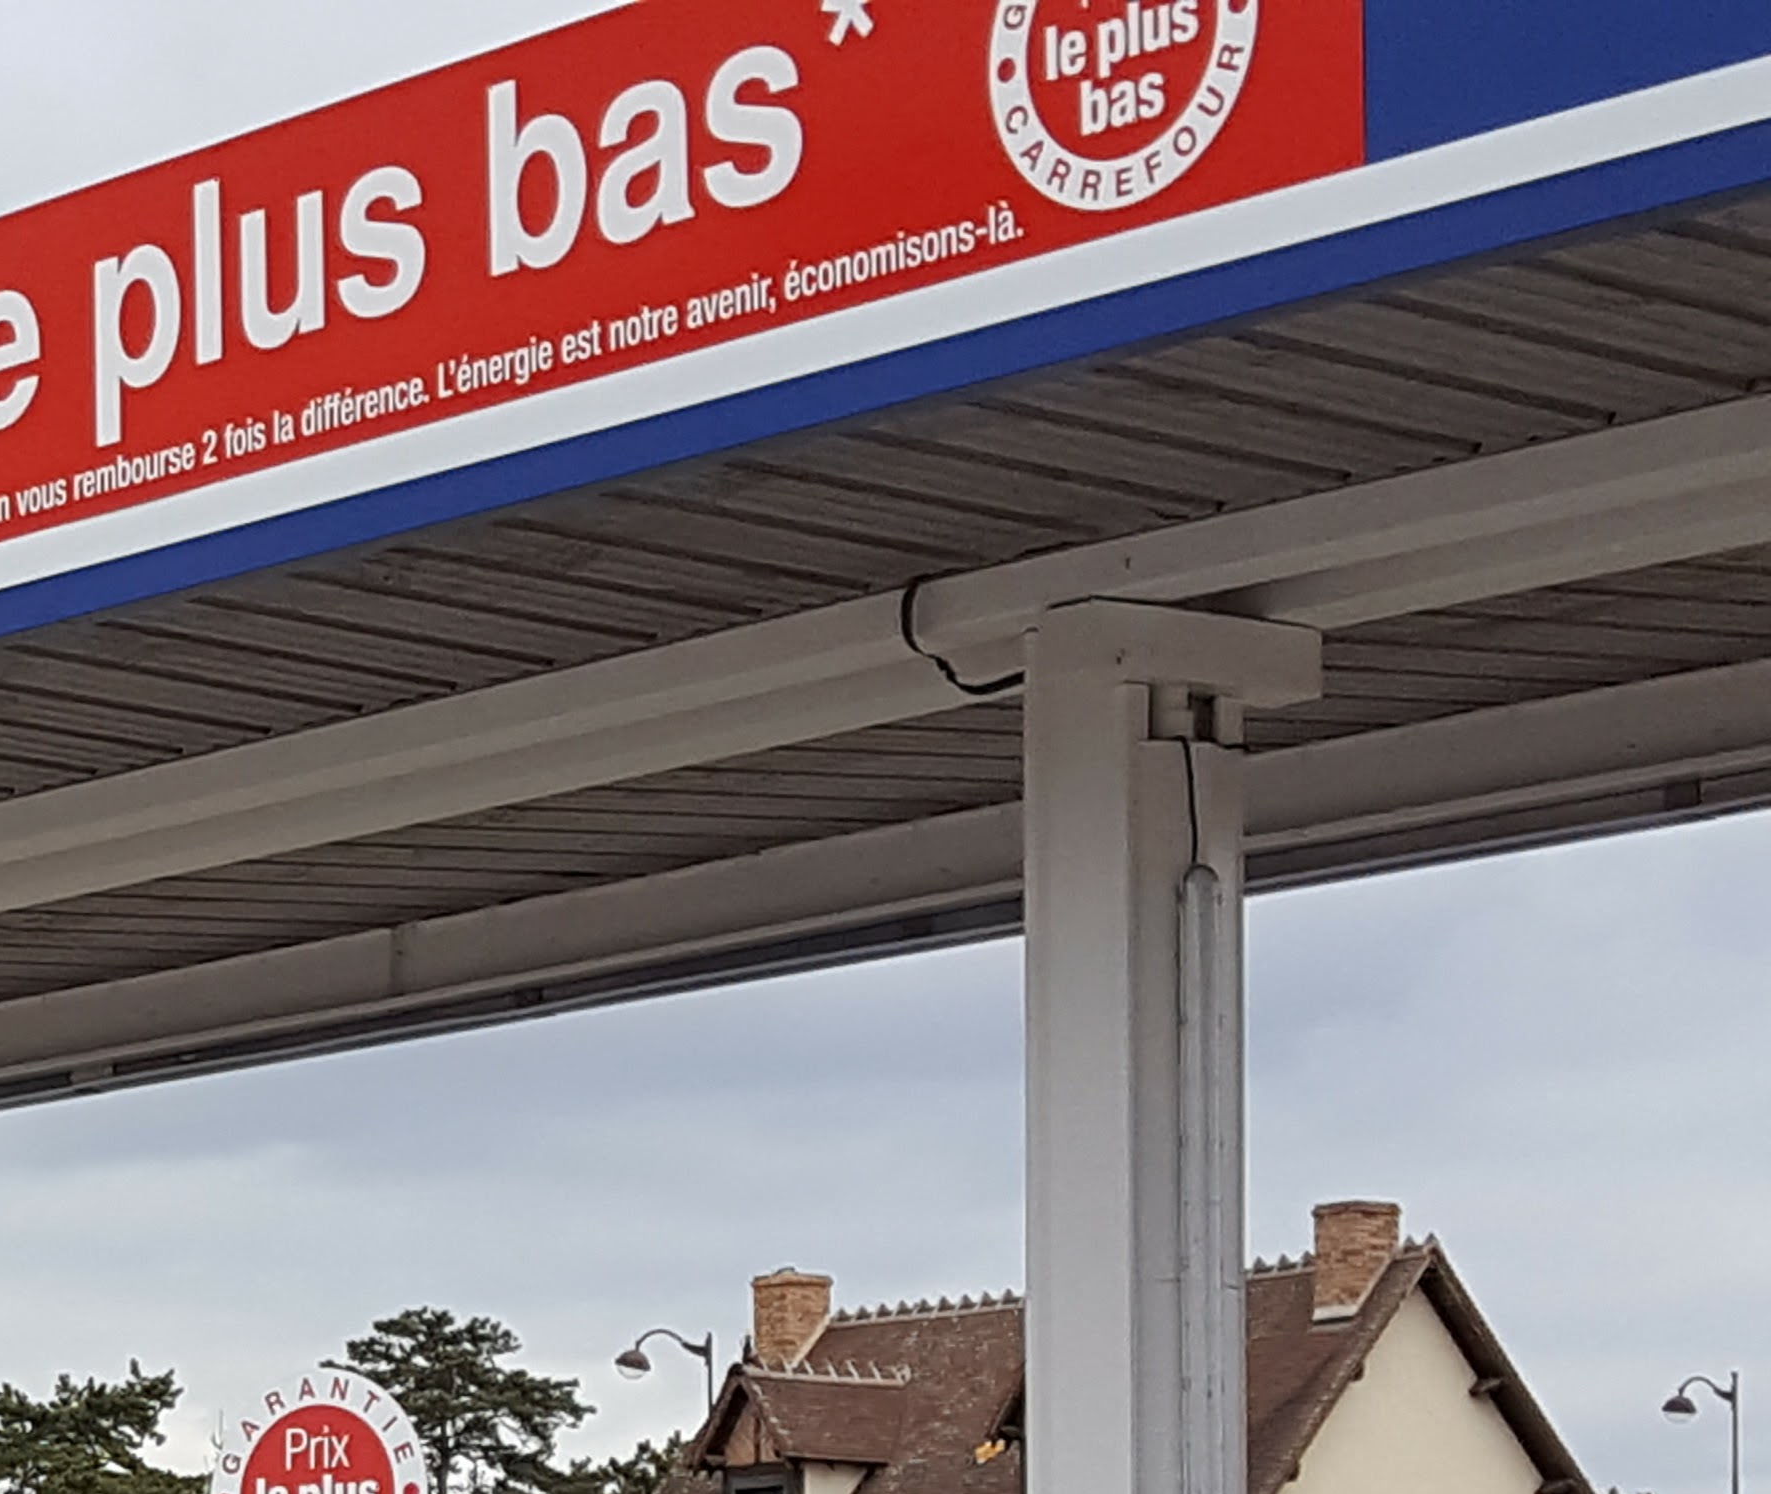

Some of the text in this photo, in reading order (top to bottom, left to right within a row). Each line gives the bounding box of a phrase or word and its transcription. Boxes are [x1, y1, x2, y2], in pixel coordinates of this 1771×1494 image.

[1044, 0, 1198, 80] le plus
[1006, 44, 1244, 200] CARREFOUR
[1080, 72, 1165, 136] bas
[94, 166, 426, 448] plus
[16, 478, 67, 516] vous
[74, 443, 195, 500] rembourse
[203, 431, 217, 465] 2
[224, 416, 266, 458] fois
[272, 411, 295, 446] la
[301, 377, 430, 437] différence.
[439, 337, 553, 398] L'énergie
[561, 328, 602, 365] est
[610, 305, 679, 351] notre
[686, 273, 777, 329] avenir,
[784, 200, 1024, 301] économisons-là.
[222, 1376, 415, 1475] GARANTIE
[285, 1424, 350, 1471] Prix
